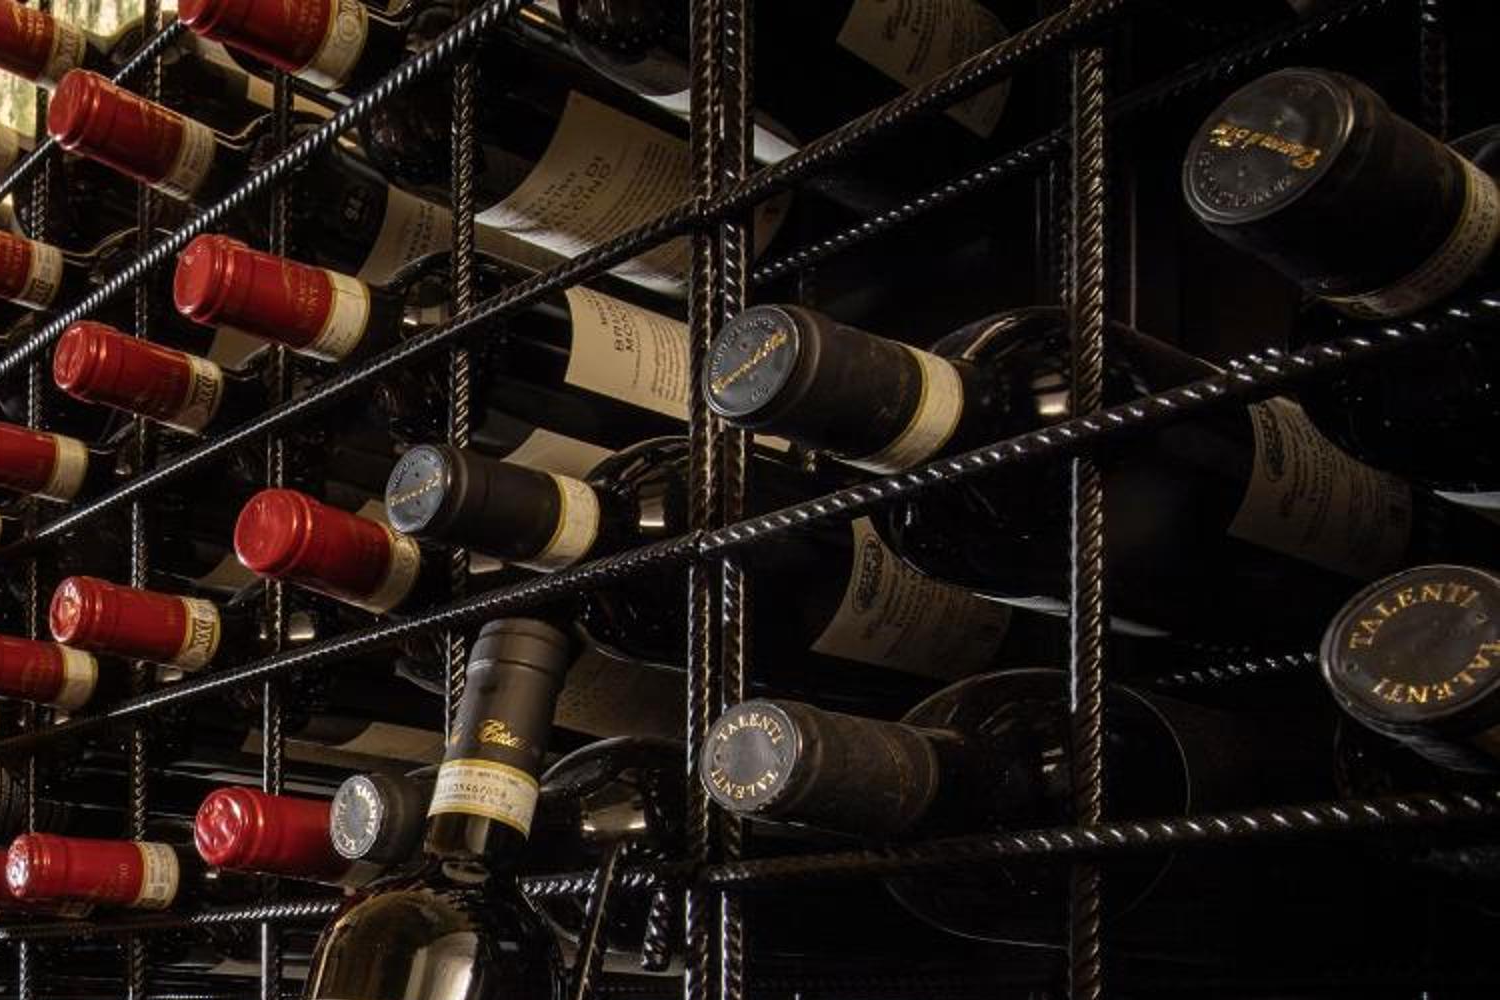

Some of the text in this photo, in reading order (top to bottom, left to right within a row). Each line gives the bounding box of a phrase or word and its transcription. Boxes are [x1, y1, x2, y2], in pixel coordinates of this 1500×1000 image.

[1349, 583, 1480, 649] TALENTI
[716, 713, 785, 744] TALENTI
[710, 768, 779, 800] TALENTI
